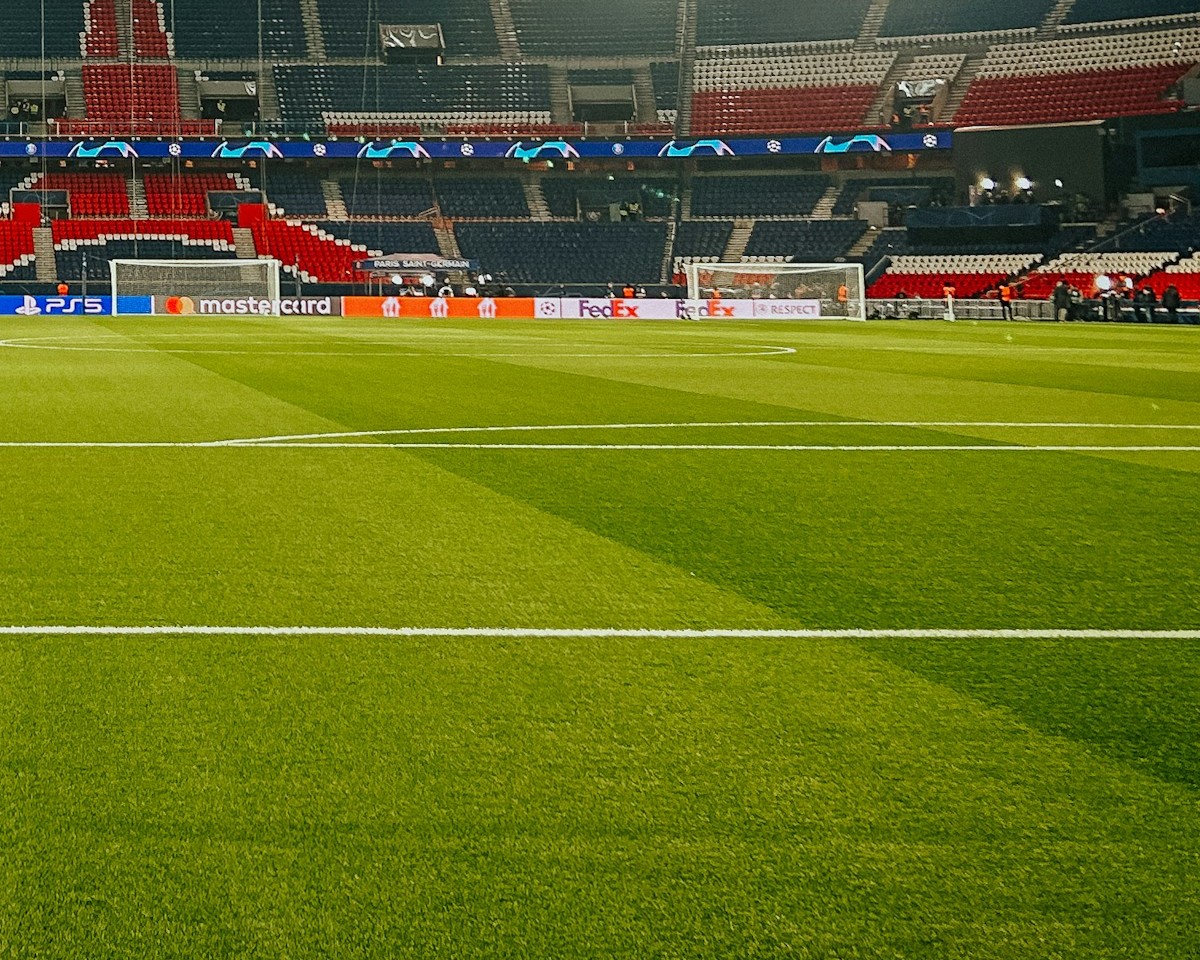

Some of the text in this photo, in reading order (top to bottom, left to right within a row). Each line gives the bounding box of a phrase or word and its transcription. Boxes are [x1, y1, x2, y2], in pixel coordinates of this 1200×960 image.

[374, 260, 470, 268] PARIS SAINT-GERMAIN
[45, 299, 104, 314] PS5
[200, 296, 331, 315] mastercard
[579, 299, 639, 318] FedEx
[771, 305, 816, 315] RESPECT
